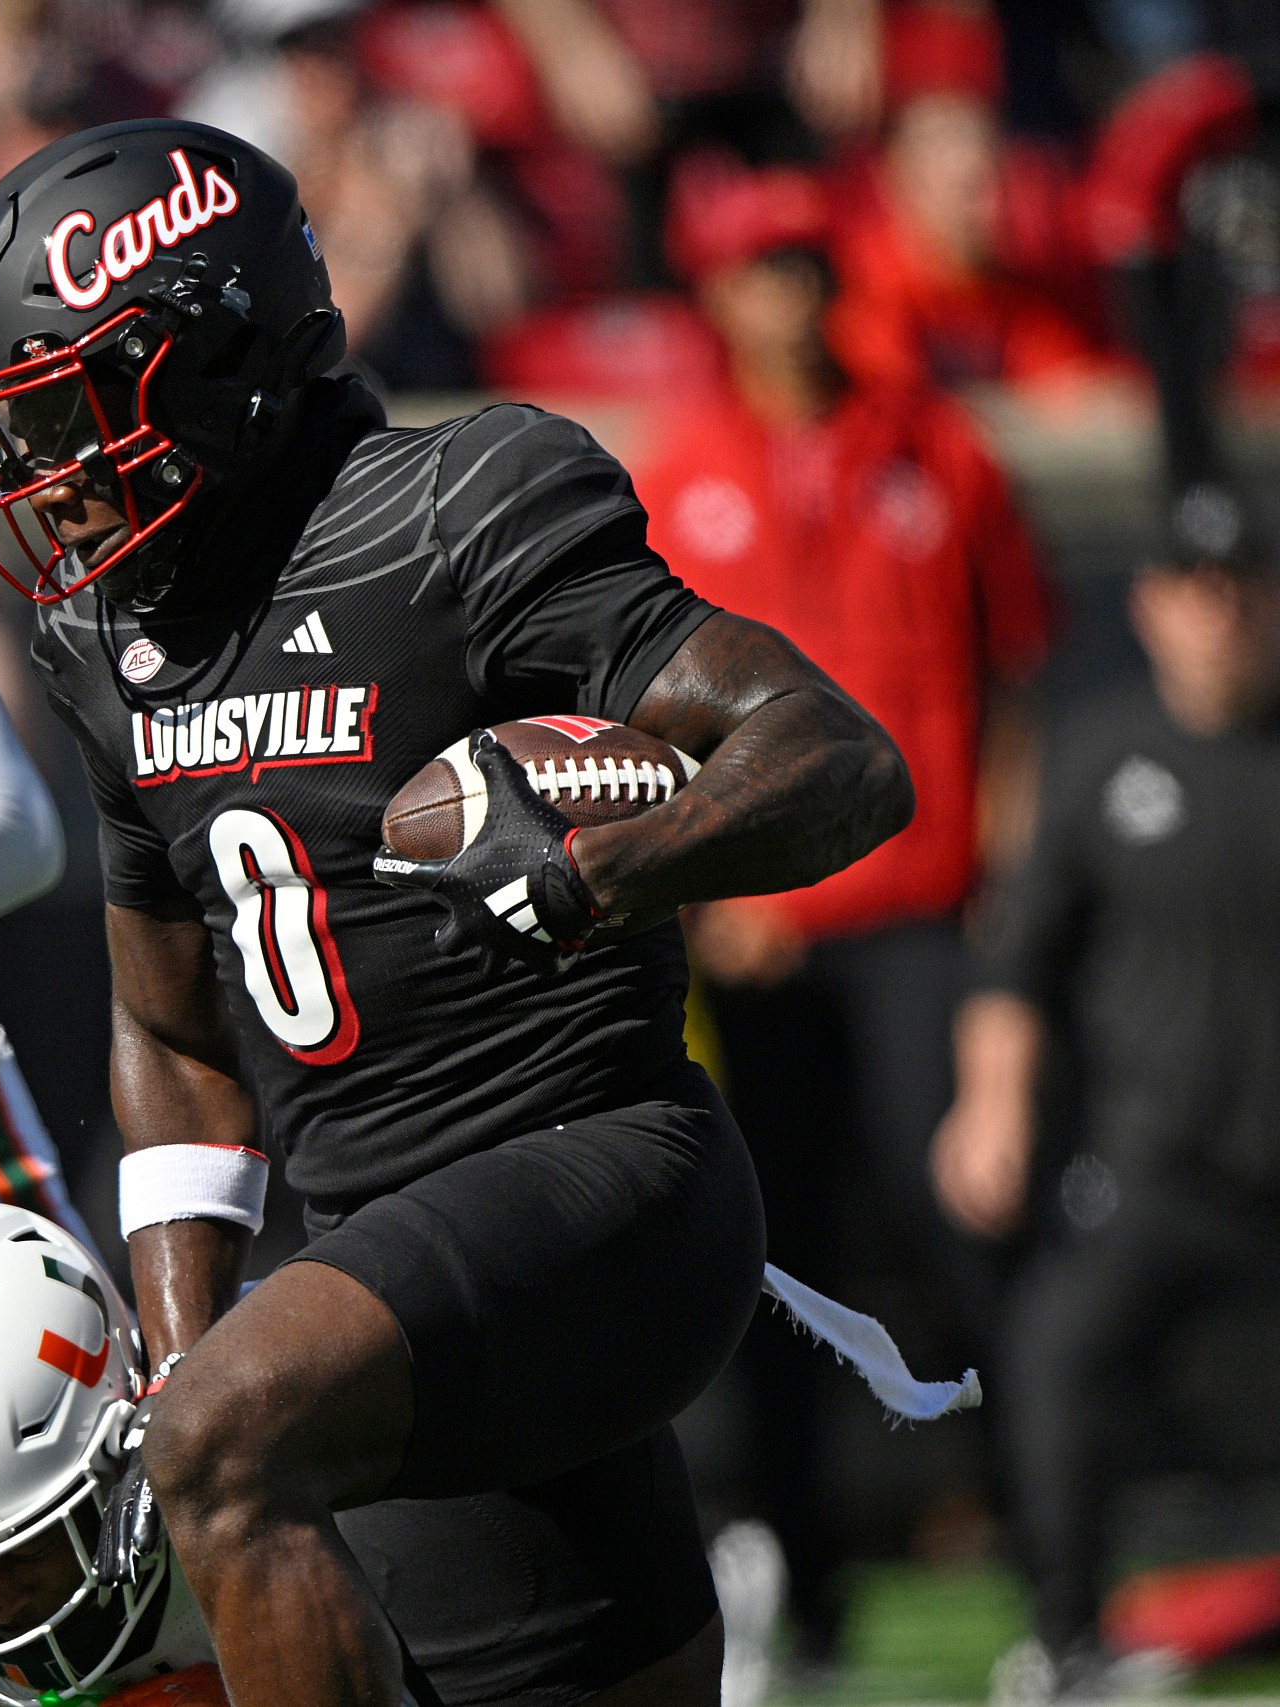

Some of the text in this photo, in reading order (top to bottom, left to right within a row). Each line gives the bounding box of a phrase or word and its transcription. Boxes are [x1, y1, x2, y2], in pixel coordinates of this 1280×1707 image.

[47, 149, 241, 310] Cards
[127, 646, 158, 669] ACC
[131, 685, 376, 785] LOUISVILLE
[373, 857, 419, 875] ADIZERO
[209, 807, 358, 1064] 0
